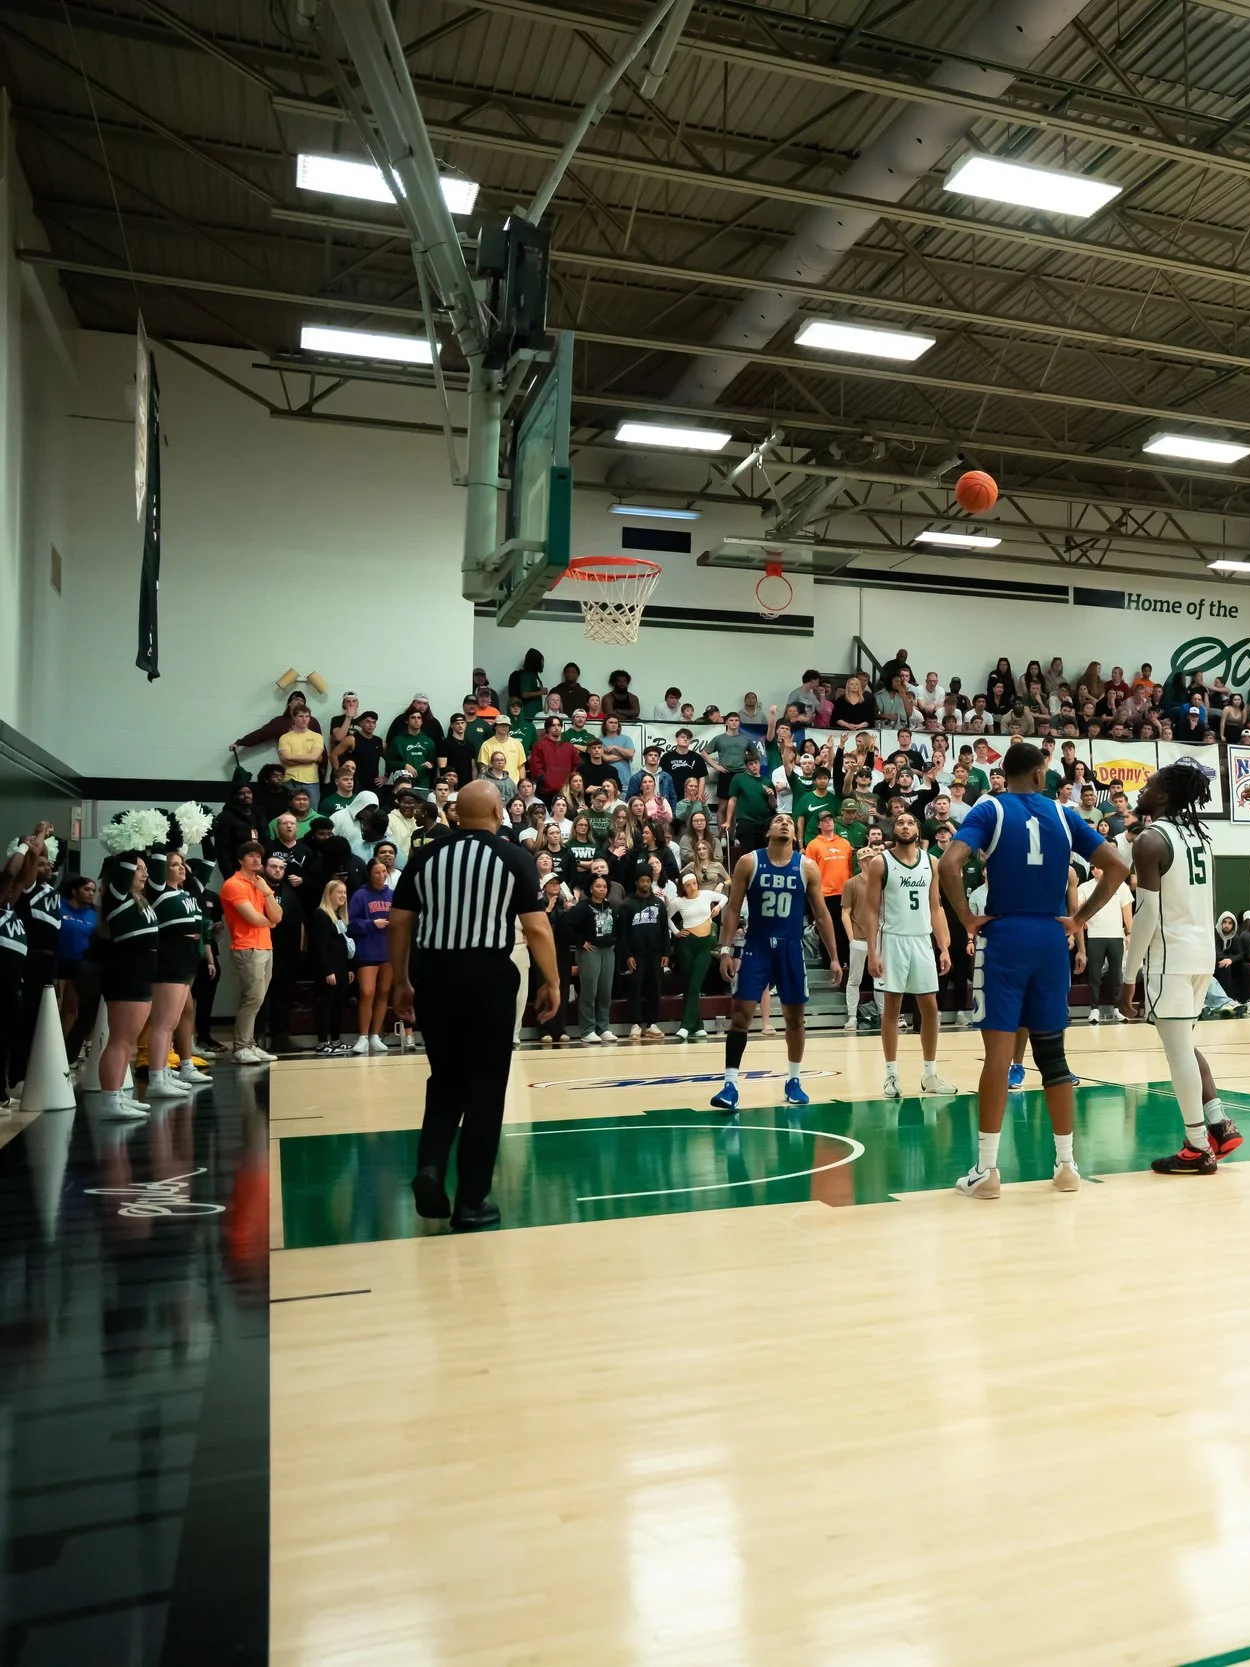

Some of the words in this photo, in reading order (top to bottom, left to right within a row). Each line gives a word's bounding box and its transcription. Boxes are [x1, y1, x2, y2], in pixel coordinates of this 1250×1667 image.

[1126, 592, 1182, 614] Home
[1186, 599, 1205, 620] of
[1209, 600, 1239, 619] the
[1099, 765, 1150, 784] Denny's
[1026, 815, 1044, 866] 1
[1185, 846, 1207, 885] 15
[760, 873, 797, 889] CBC
[899, 875, 926, 888] Woods
[761, 891, 793, 918] 20
[909, 891, 919, 911] 5
